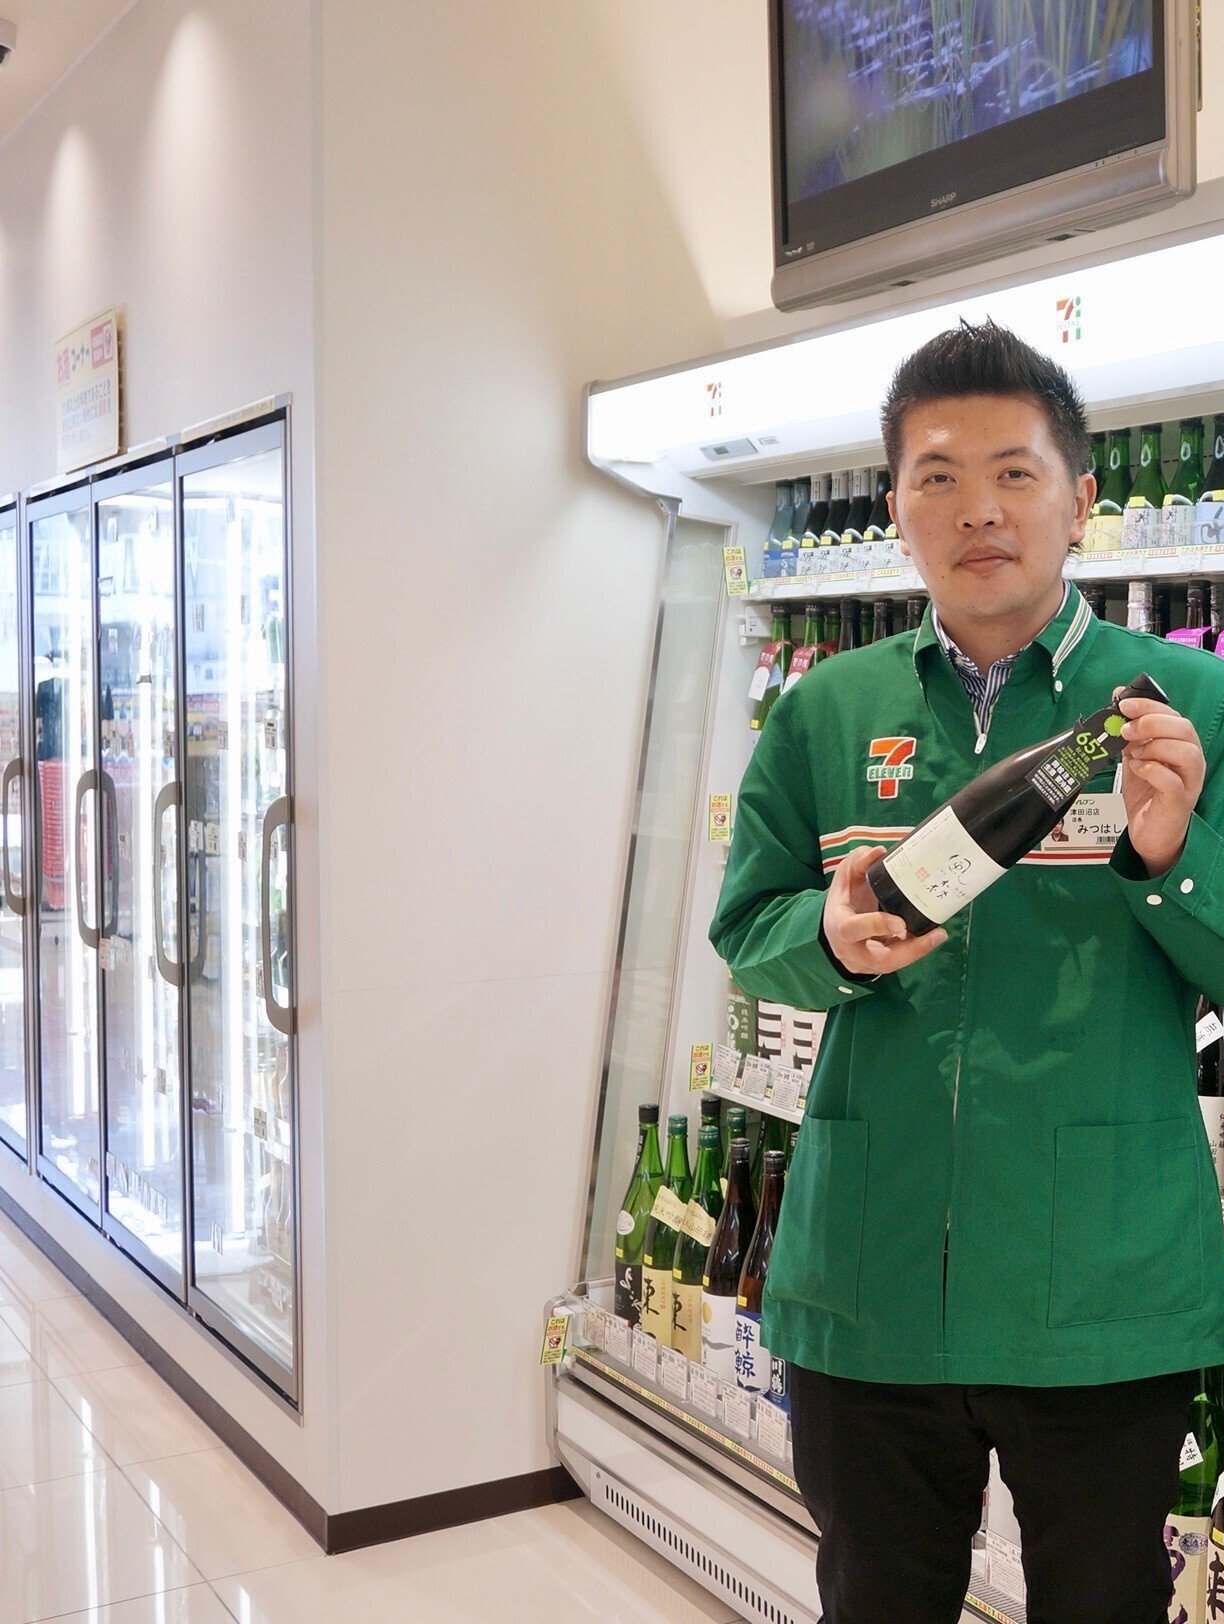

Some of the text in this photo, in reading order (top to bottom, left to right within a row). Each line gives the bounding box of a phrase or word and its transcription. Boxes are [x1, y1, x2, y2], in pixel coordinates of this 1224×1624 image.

[931, 191, 957, 208] SHARP
[1076, 731, 1109, 761] 657
[1070, 808, 1100, 816] 津田沼店
[1077, 824, 1122, 834] みつはし
[735, 1321, 756, 1379] 酔鯨
